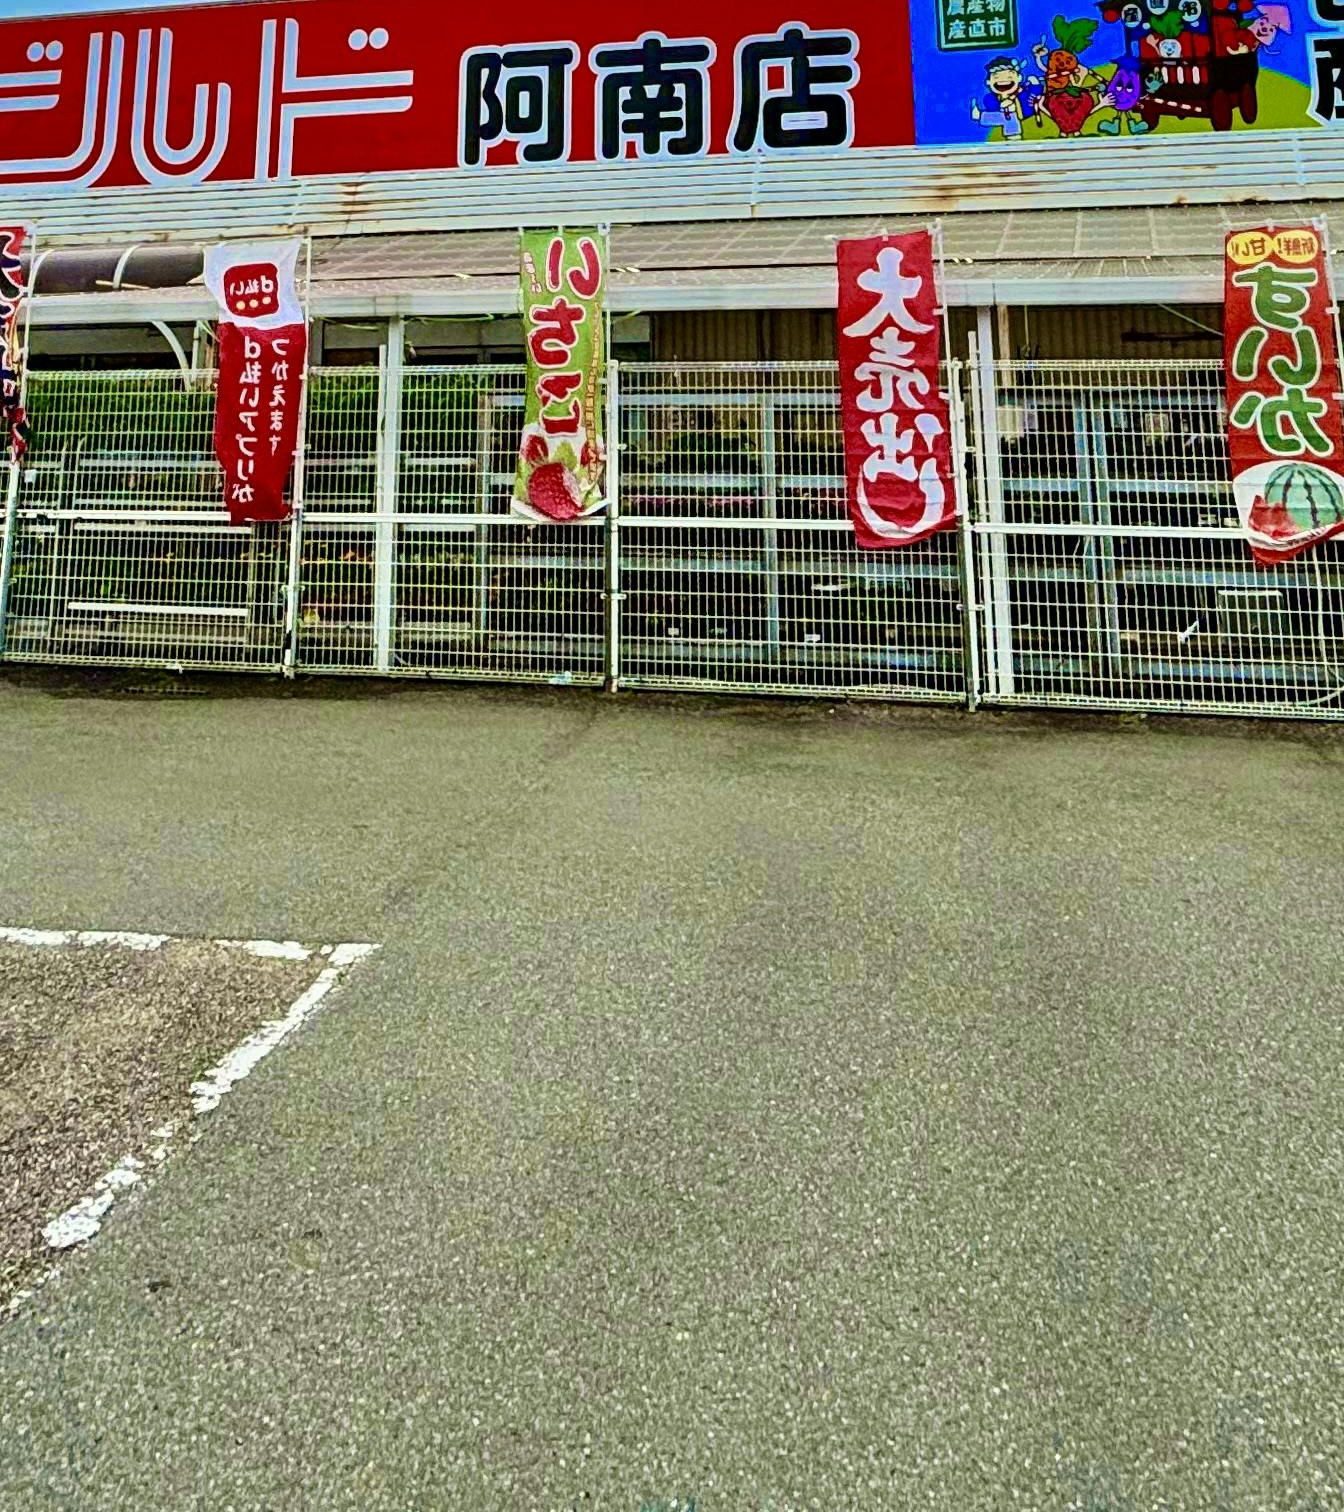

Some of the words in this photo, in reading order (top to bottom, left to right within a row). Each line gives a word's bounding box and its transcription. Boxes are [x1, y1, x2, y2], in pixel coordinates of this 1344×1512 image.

[948, 16, 1006, 40] 産直市
[458, 20, 860, 170] 阿南店
